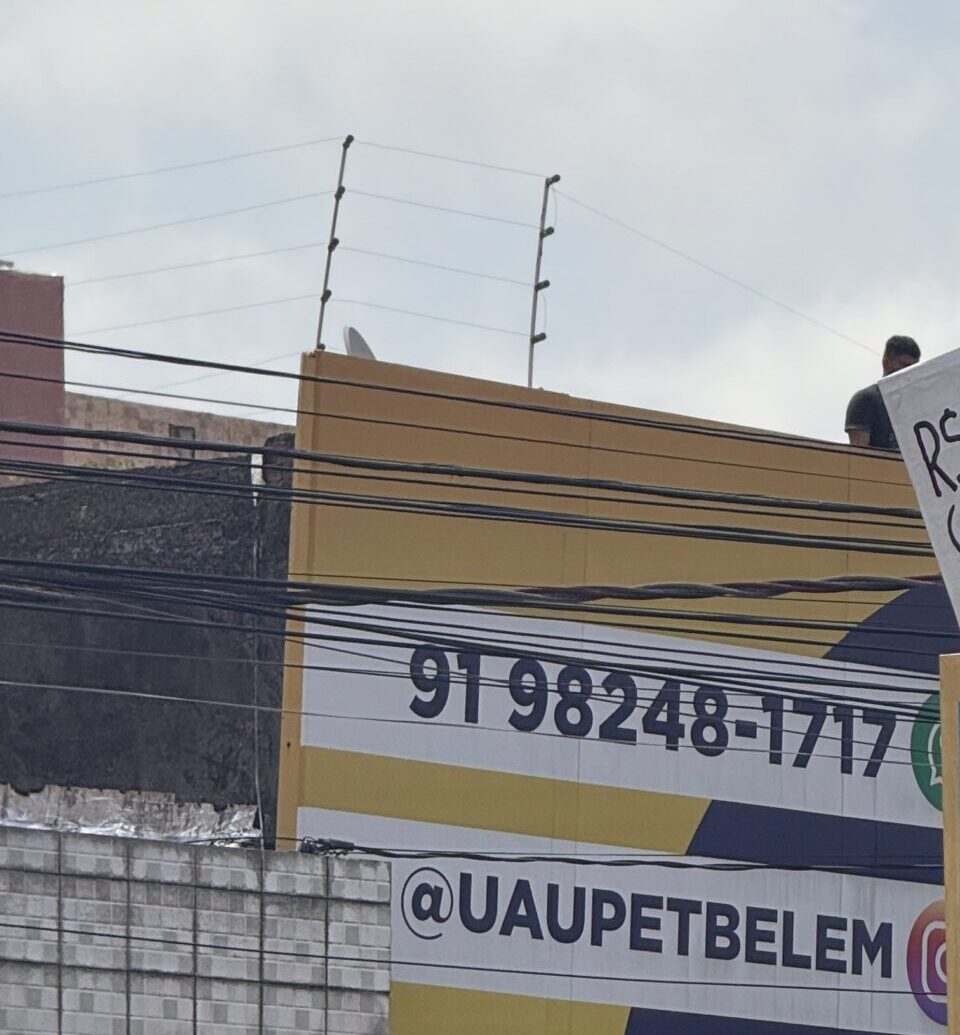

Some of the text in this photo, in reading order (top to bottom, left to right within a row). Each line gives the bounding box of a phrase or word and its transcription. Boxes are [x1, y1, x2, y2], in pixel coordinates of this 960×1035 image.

[409, 643, 897, 778] 91 98248-1717
[400, 866, 893, 979] @UAUPETBELEM
